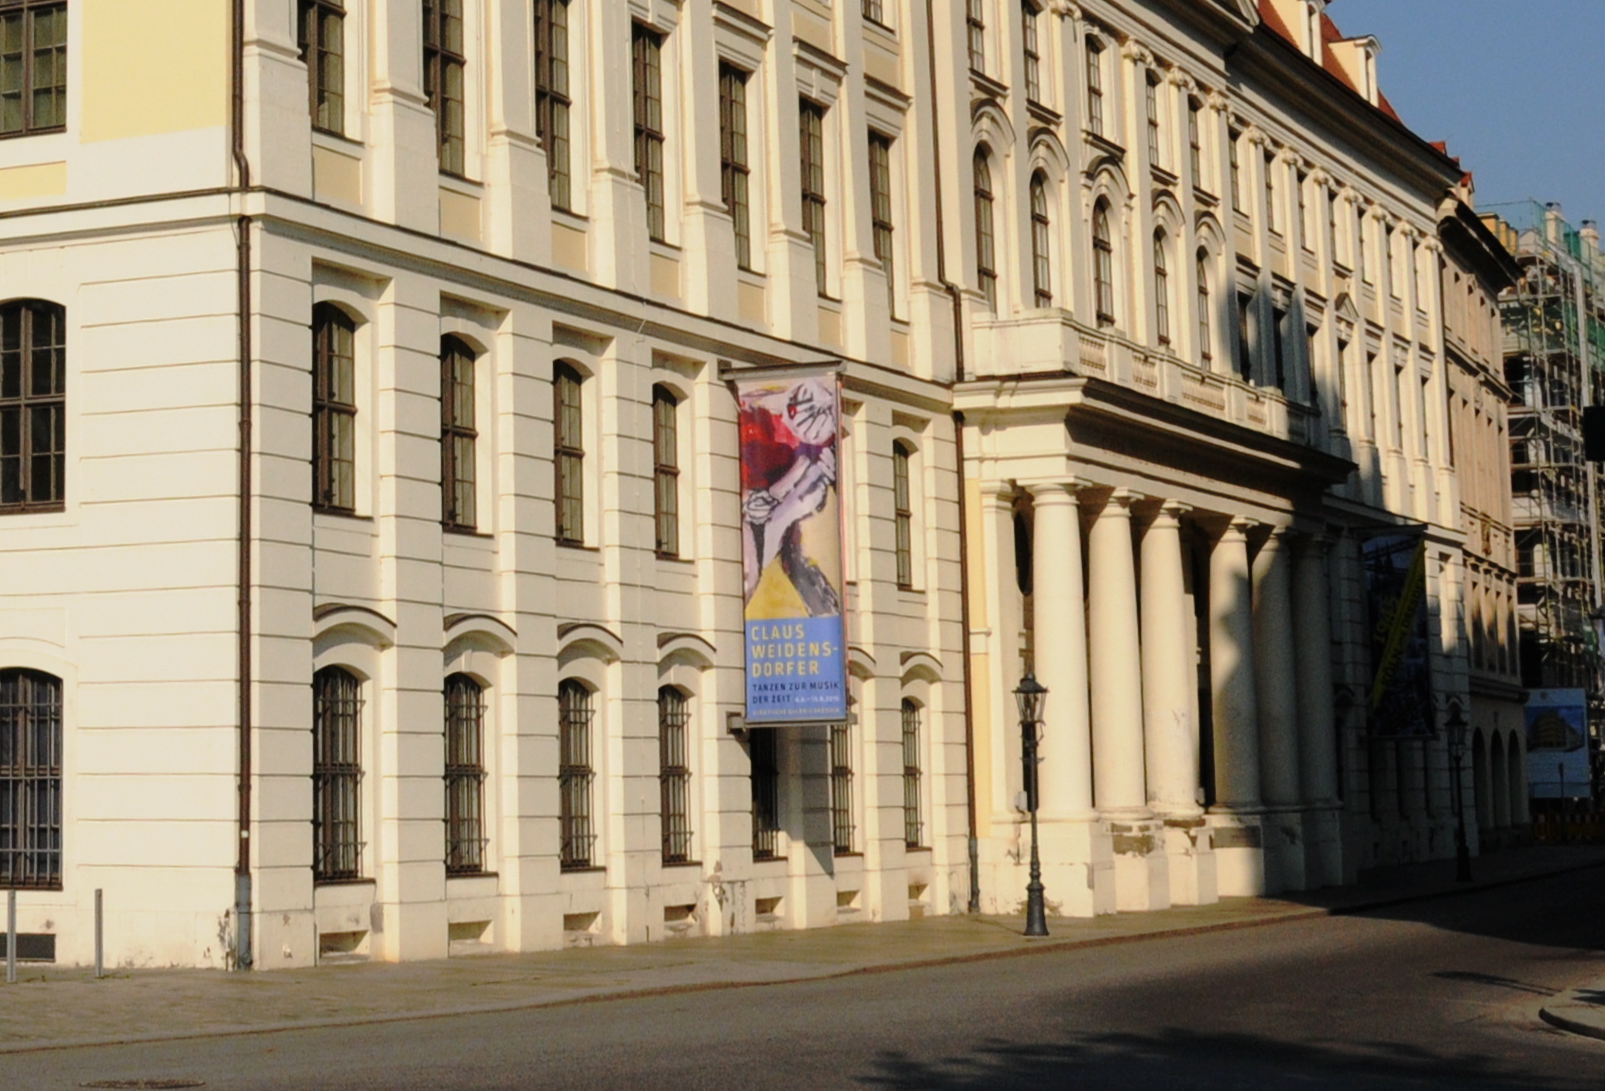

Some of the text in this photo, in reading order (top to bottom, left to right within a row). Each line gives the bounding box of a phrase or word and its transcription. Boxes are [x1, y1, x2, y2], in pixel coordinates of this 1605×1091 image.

[751, 624, 805, 641] CLAUS
[751, 641, 839, 659] WEIDENS-
[752, 660, 820, 678] DORFER
[752, 681, 839, 692] TANZEN ZUR MUSIK
[752, 695, 770, 704] DER
[771, 694, 791, 703] ZEIT
